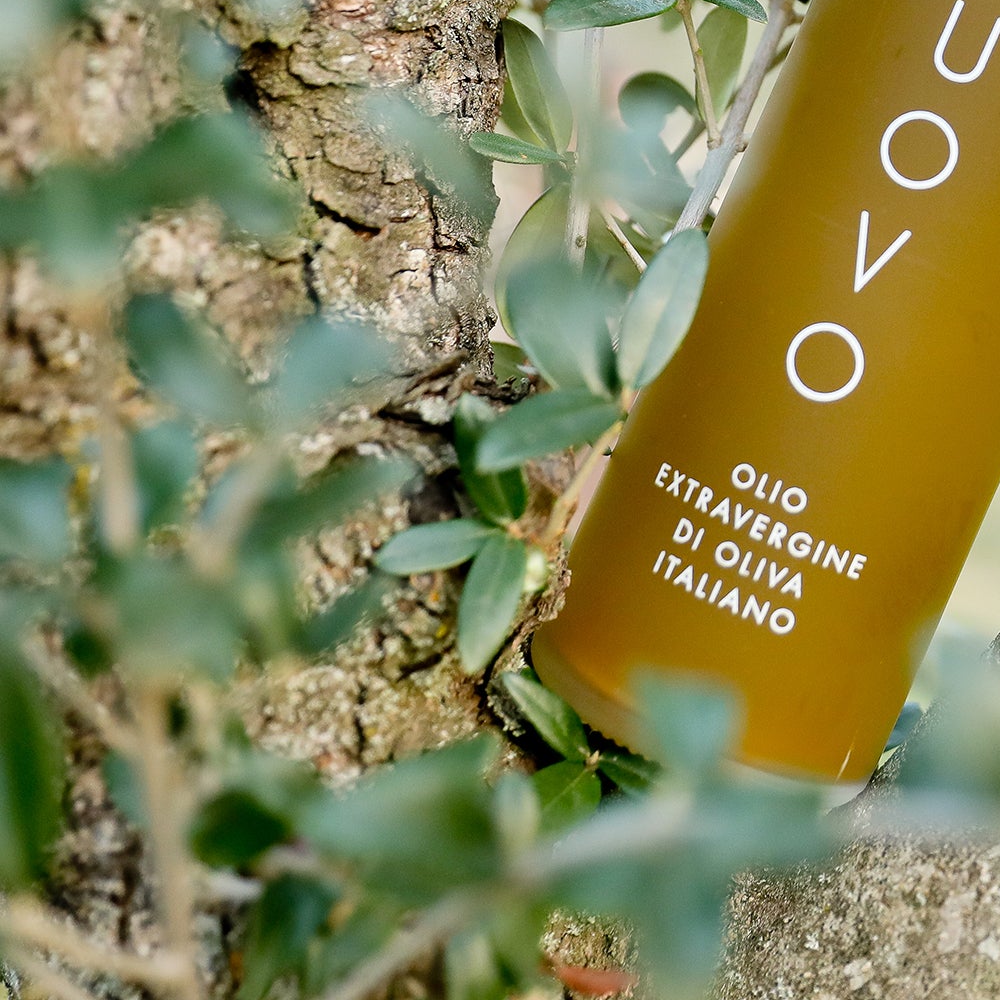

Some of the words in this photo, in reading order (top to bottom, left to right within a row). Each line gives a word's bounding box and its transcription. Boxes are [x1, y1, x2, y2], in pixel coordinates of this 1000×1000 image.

[655, 462, 868, 580] EXTRAVERGINE
[731, 462, 808, 514] OLIO
[652, 550, 796, 635] ITALIANO
[672, 517, 705, 551] DI
[714, 541, 802, 599] OLIVA
